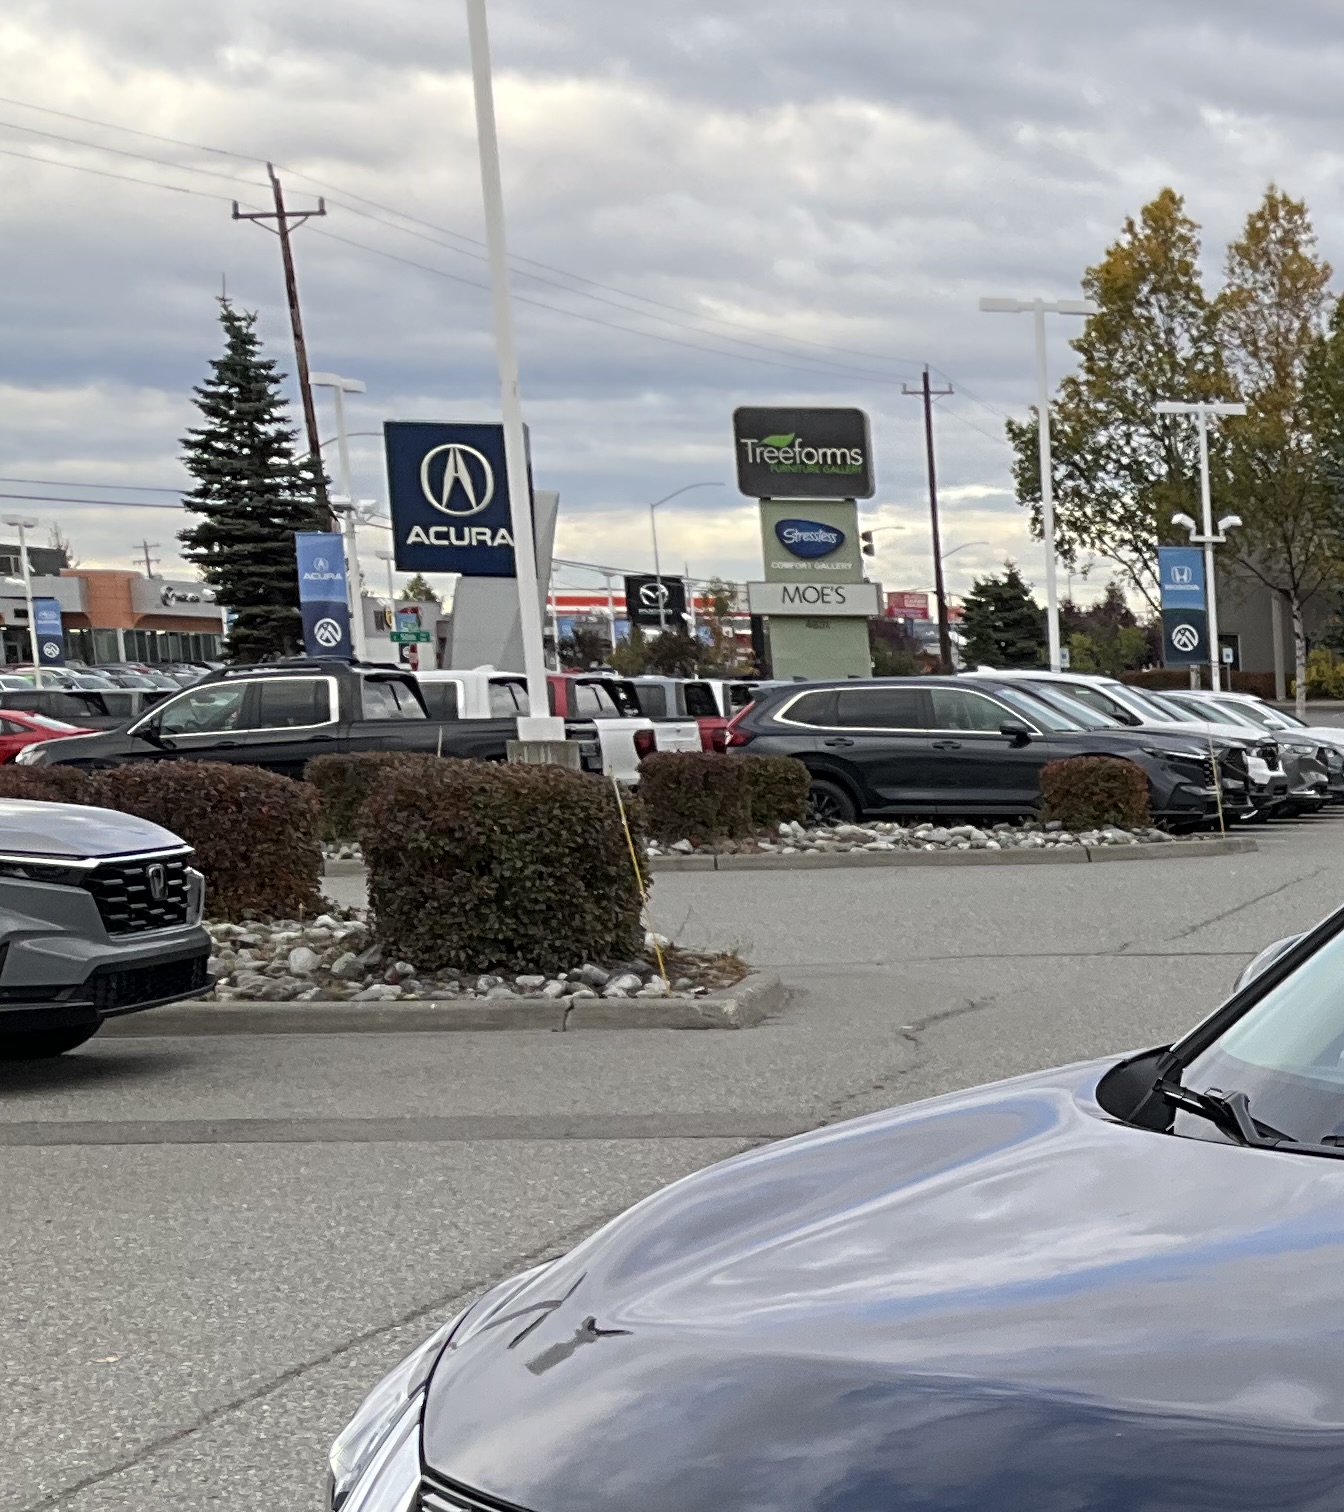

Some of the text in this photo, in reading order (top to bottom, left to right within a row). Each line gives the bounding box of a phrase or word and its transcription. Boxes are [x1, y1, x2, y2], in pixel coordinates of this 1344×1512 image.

[740, 438, 863, 466] Treeforms
[406, 525, 515, 547] ACURA
[783, 528, 837, 543] Stressless
[814, 562, 852, 570] GALLERY
[303, 572, 343, 580] ACURA
[782, 586, 846, 604] MOE'S
